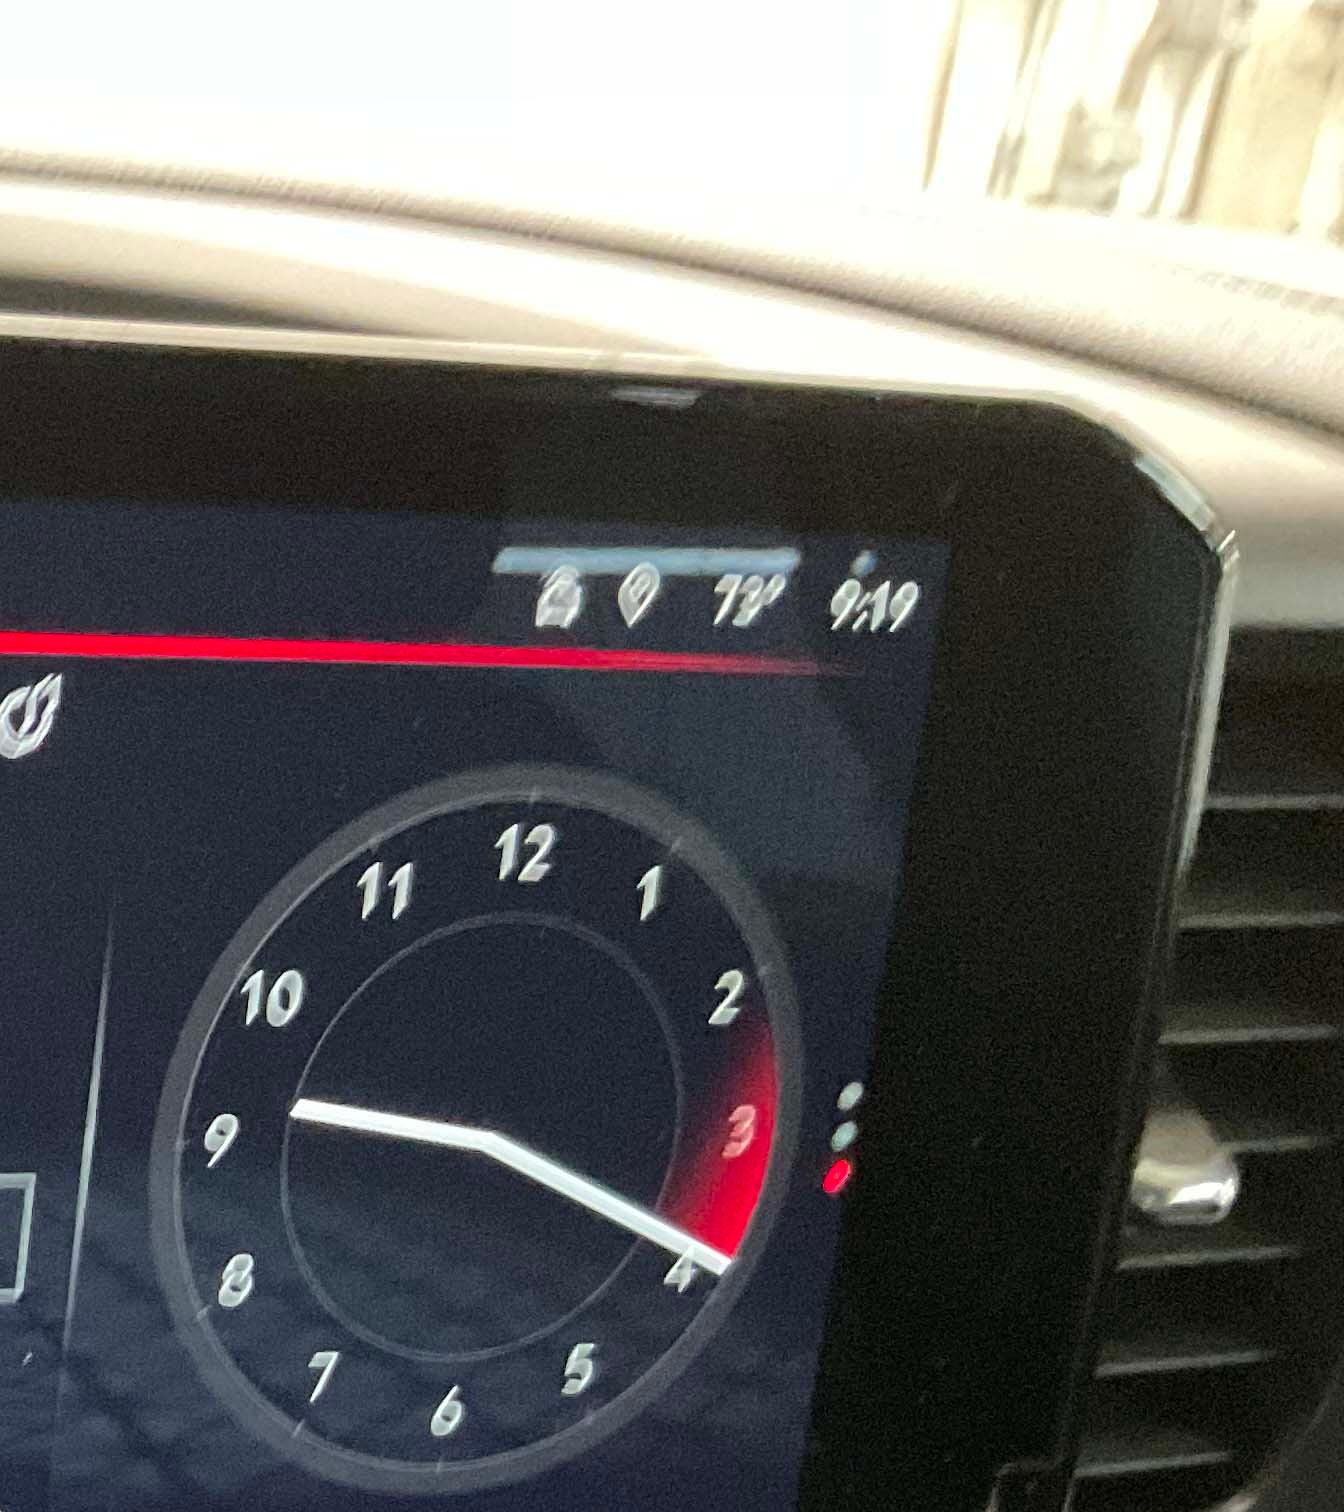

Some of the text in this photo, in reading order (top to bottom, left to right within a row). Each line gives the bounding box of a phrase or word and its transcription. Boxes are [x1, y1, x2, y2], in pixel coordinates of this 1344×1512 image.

[831, 579, 919, 632] 9:19
[495, 824, 555, 881] 12
[357, 862, 413, 919] 11
[637, 866, 662, 920] 1
[241, 969, 304, 1027] 10
[708, 970, 744, 1024] 2
[205, 1114, 238, 1167] 9
[723, 1105, 756, 1157] 3
[219, 1254, 253, 1307] 8
[663, 1244, 696, 1293] 4
[308, 1351, 339, 1403] 7
[562, 1343, 595, 1394] 5
[431, 1385, 462, 1436] 6
